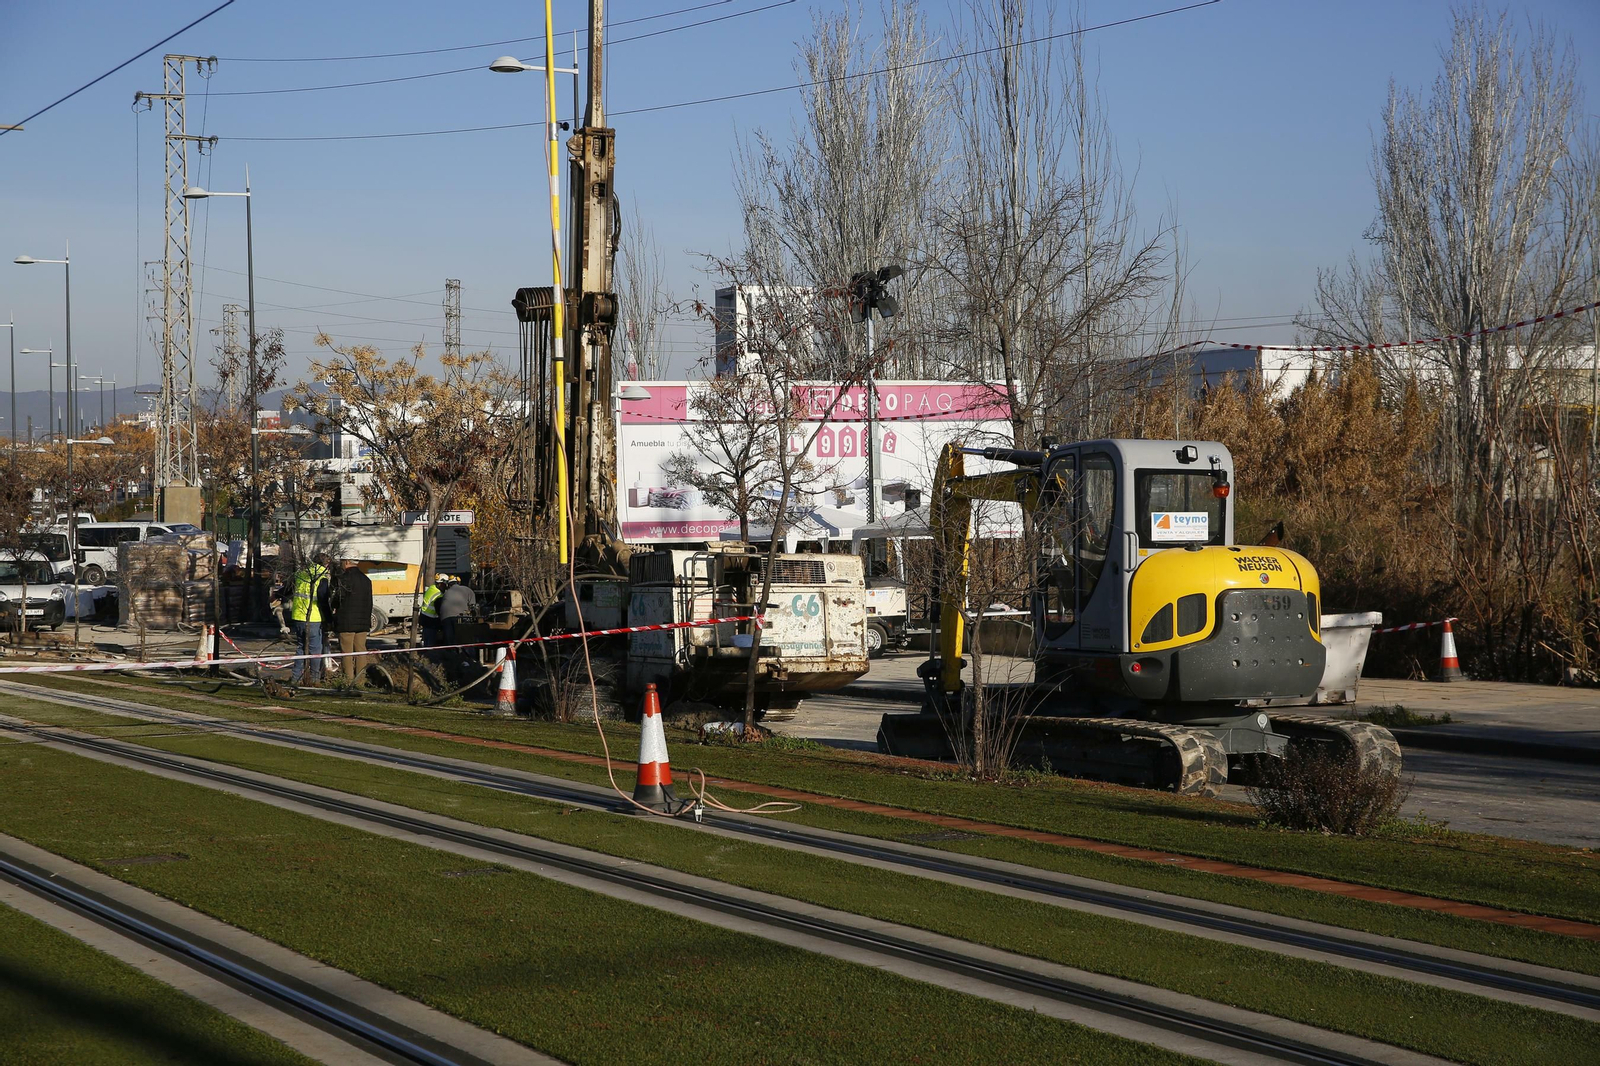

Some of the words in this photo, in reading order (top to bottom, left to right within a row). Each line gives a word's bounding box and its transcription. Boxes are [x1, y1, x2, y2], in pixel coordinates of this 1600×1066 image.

[841, 393, 952, 411] DEOPAQ
[630, 440, 665, 448] Amuebla
[1173, 515, 1208, 526] teymo
[1234, 556, 1279, 564] WACKER
[1238, 563, 1282, 572] NEUSON
[791, 594, 820, 617] C6
